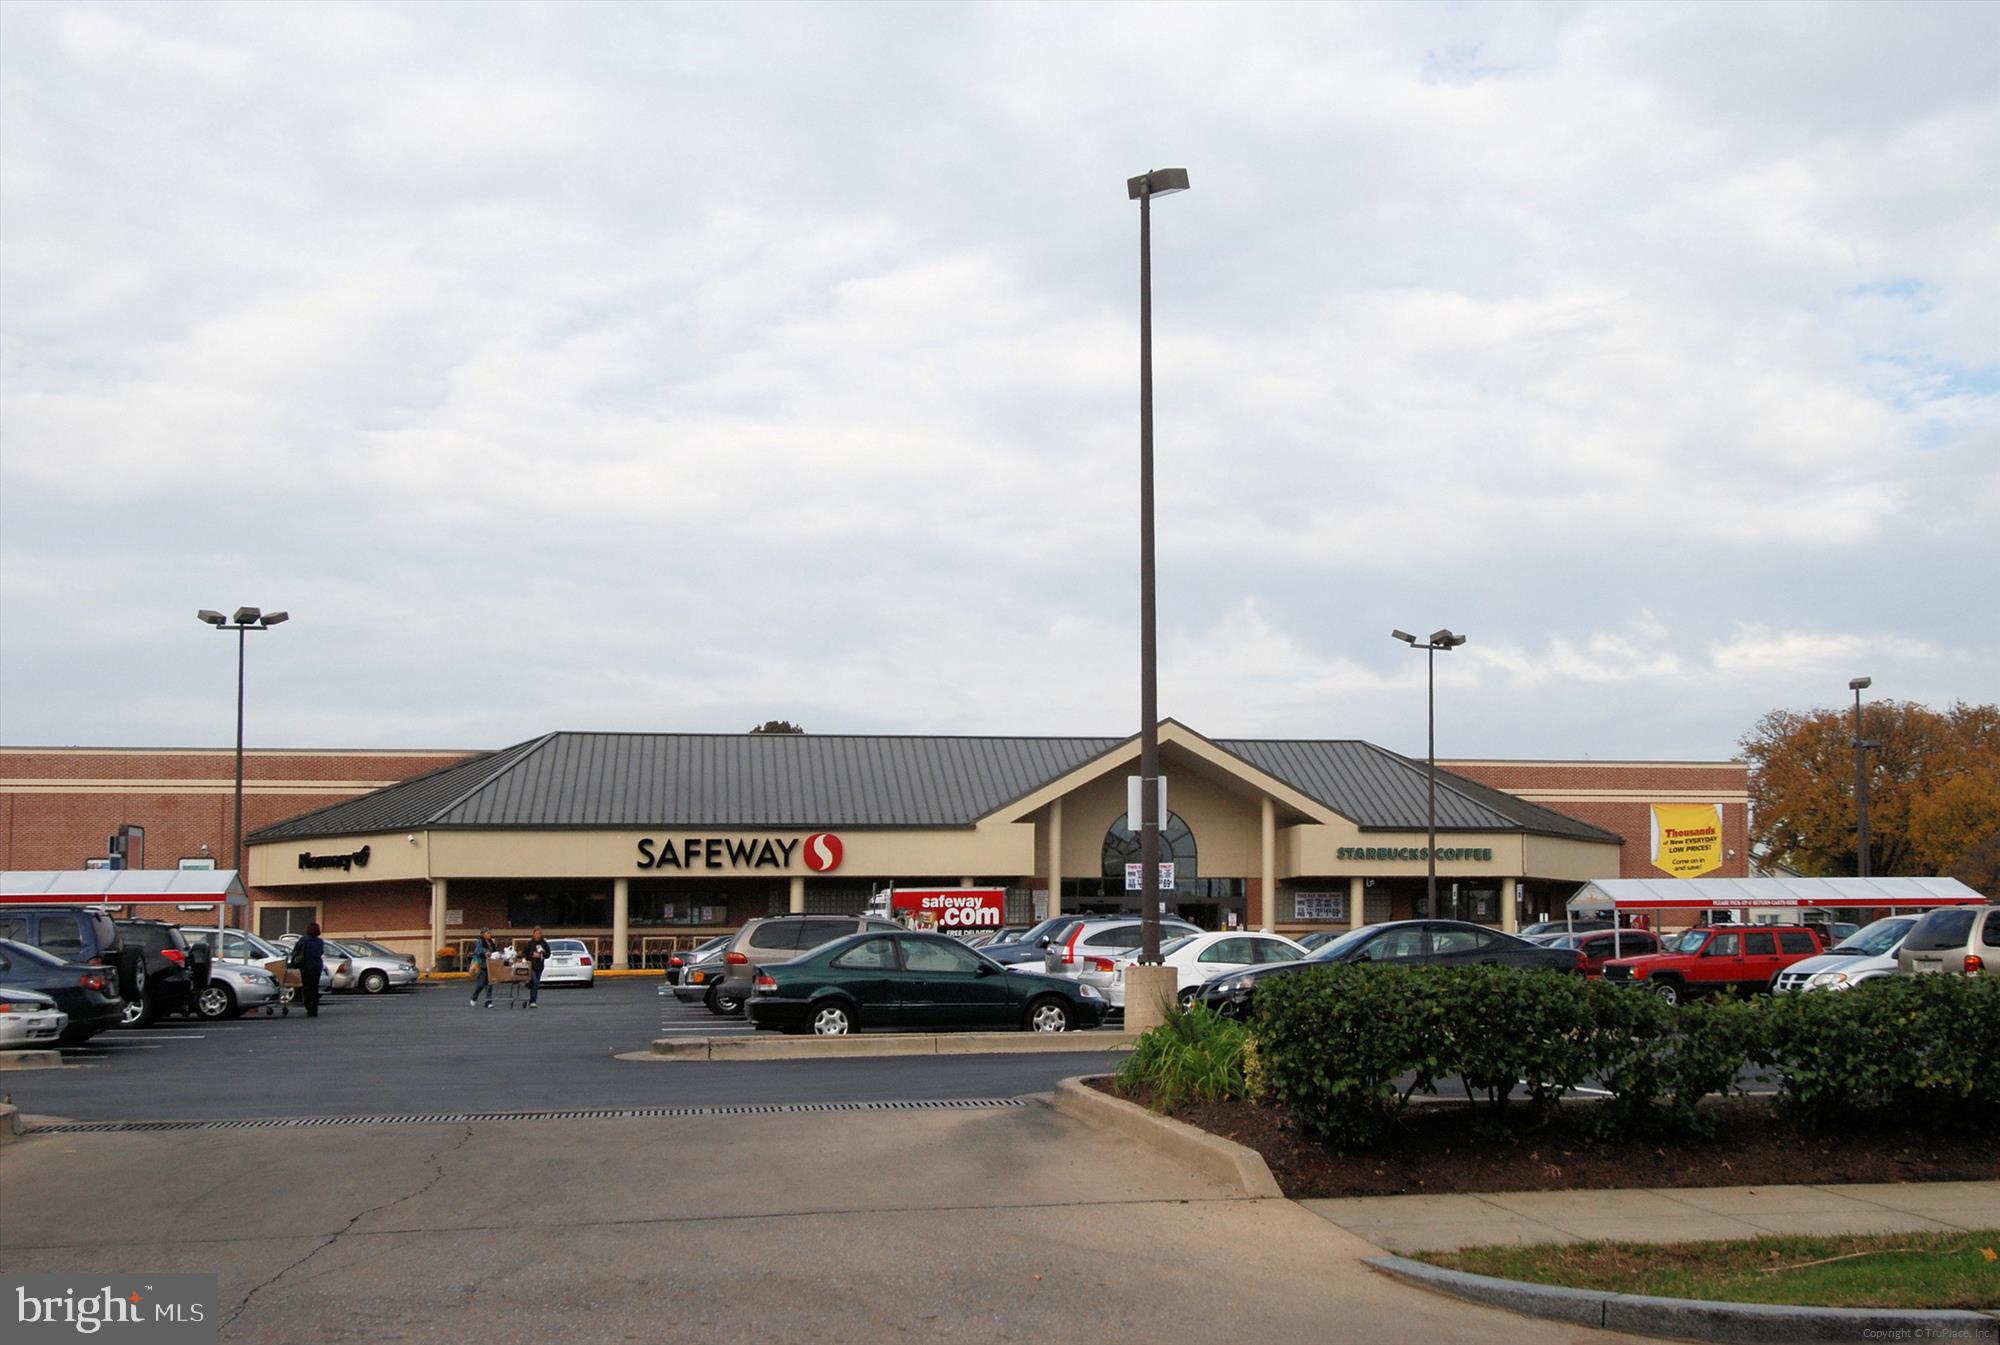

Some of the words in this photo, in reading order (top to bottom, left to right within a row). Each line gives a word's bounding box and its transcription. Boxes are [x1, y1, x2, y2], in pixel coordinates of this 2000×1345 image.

[1665, 826, 1716, 838] Thousands
[1685, 836, 1717, 844] EVERYDAY
[637, 838, 798, 869] SAFEWAY
[1337, 848, 1429, 861] STARBUCKS
[1434, 848, 1493, 861] COFFEE
[922, 895, 983, 909] safeway
[940, 907, 999, 926] .com
